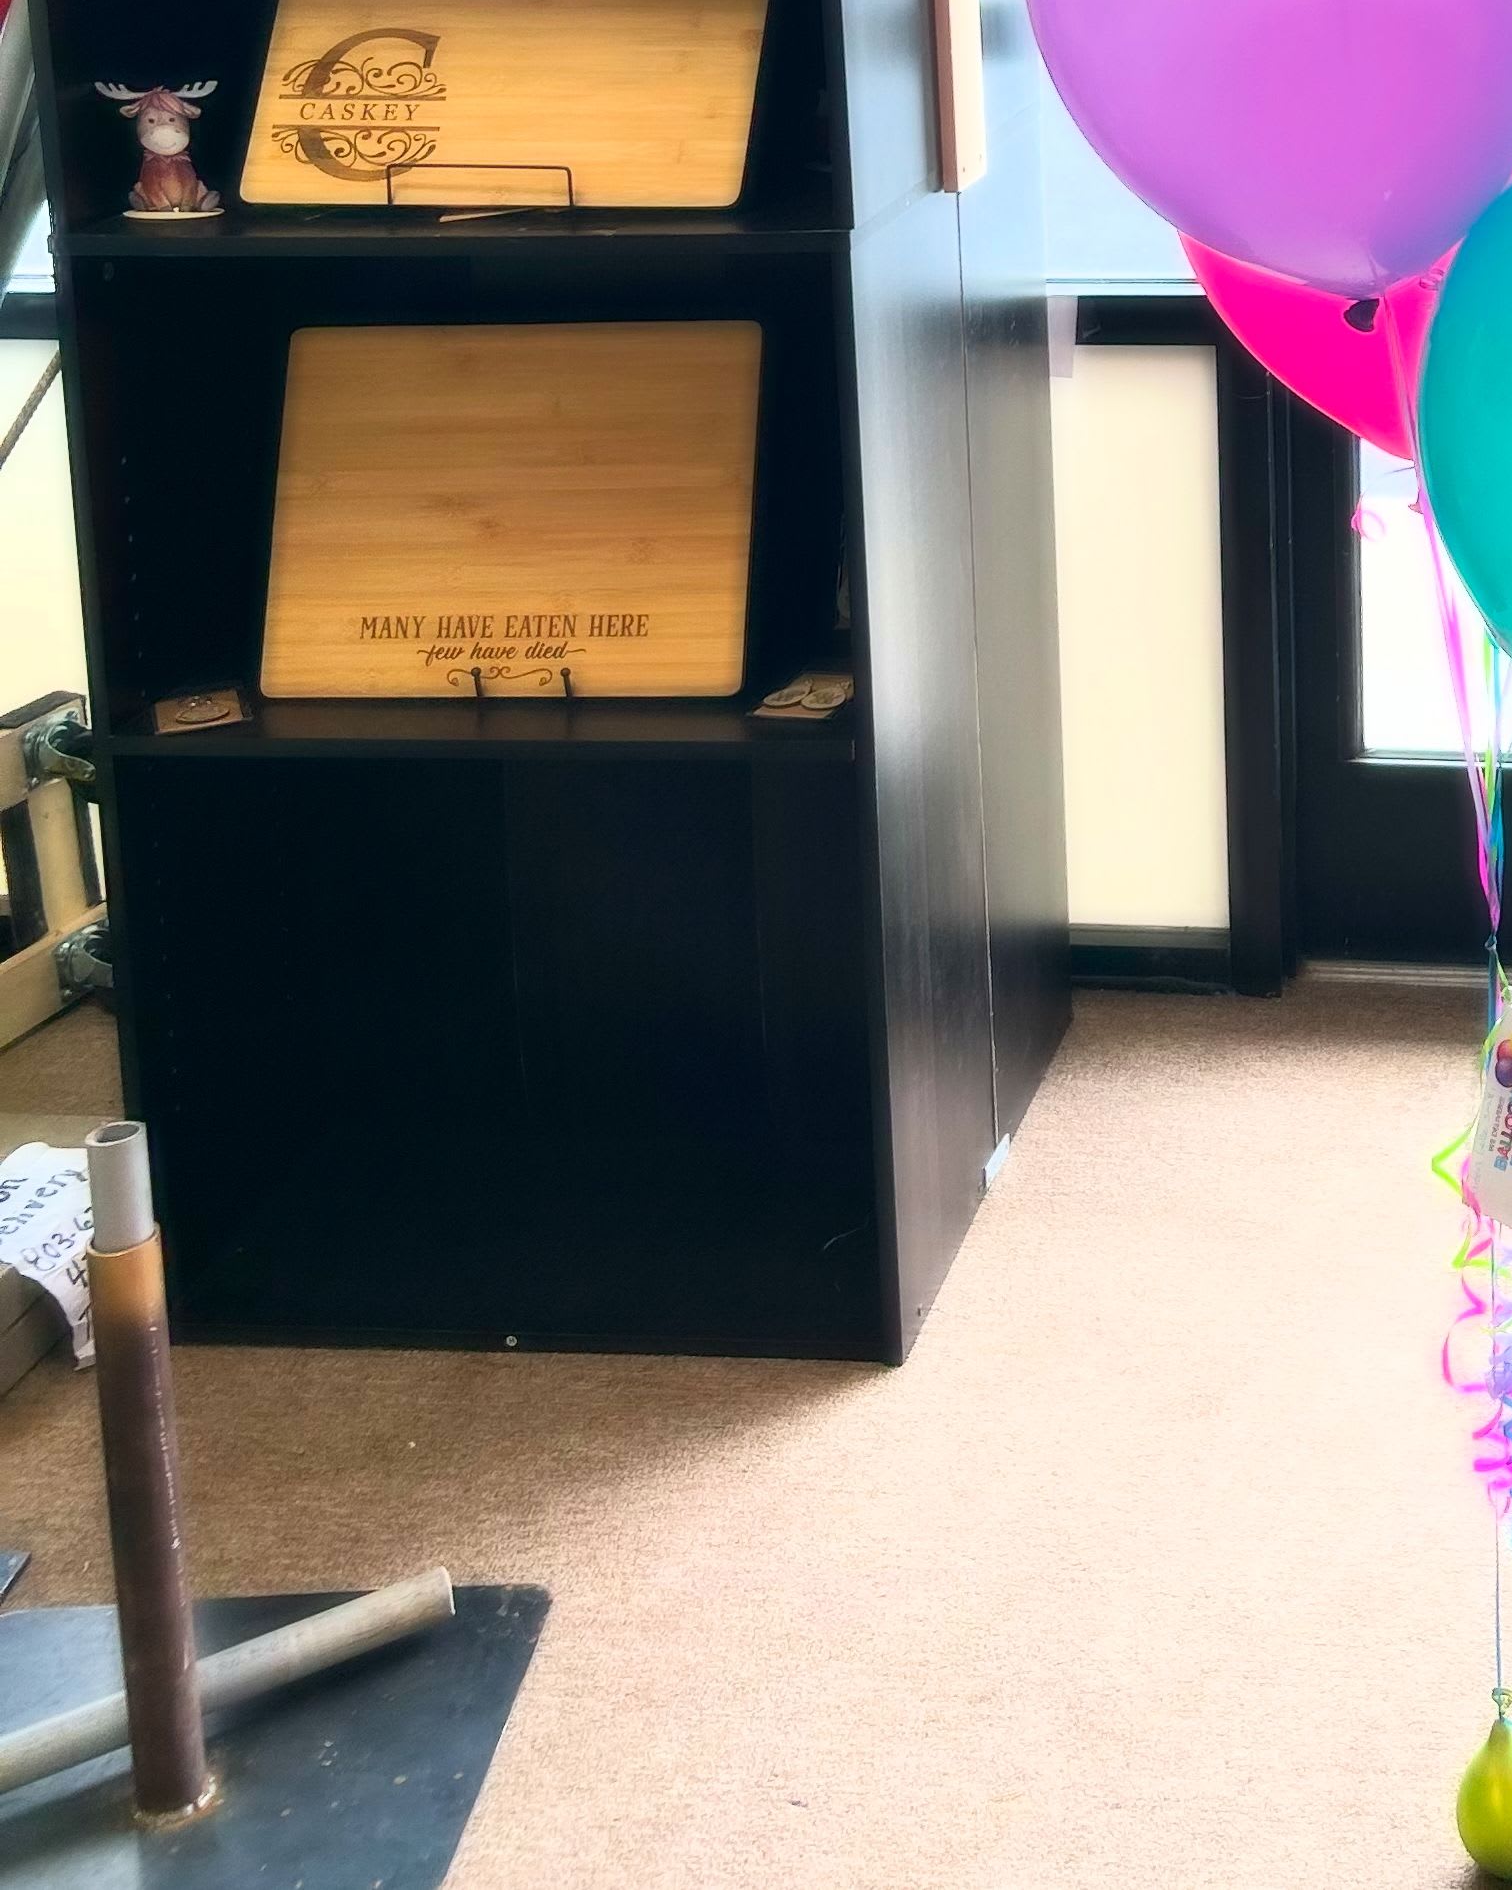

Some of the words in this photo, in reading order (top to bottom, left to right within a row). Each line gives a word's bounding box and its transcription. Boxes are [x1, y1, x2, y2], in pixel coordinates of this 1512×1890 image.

[300, 102, 421, 122] CASKEY
[360, 614, 425, 639] MANY
[437, 614, 494, 638] HAVE
[504, 614, 577, 639] EATEN
[589, 613, 650, 638] HERE
[419, 642, 464, 666] few
[470, 641, 518, 659] have
[525, 641, 573, 659] died
